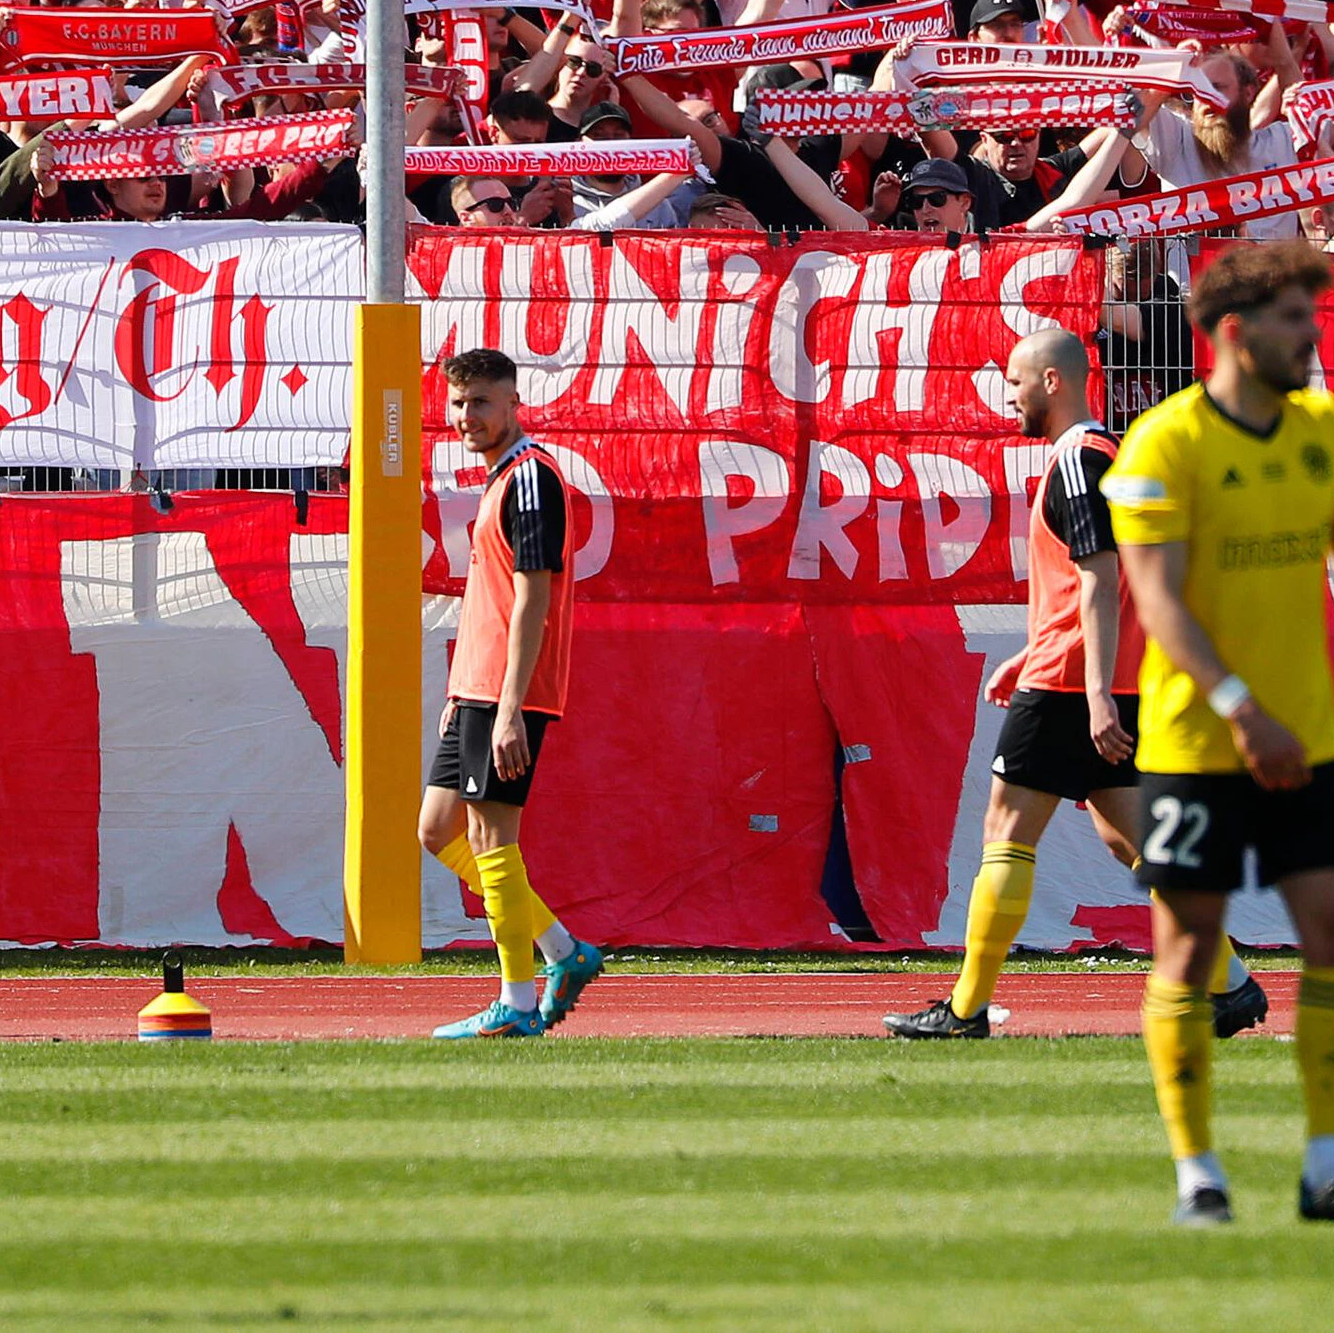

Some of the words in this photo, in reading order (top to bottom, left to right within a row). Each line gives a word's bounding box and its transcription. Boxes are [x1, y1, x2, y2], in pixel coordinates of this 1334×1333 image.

[617, 37, 664, 75] Gute
[672, 33, 746, 65] Freunde
[751, 28, 797, 61] kann
[802, 15, 877, 52] niemand
[935, 46, 1001, 67] GERD
[1041, 93, 1131, 117] PRIDE
[1065, 185, 1219, 239] FORZA
[1141, 796, 1209, 866] 22
